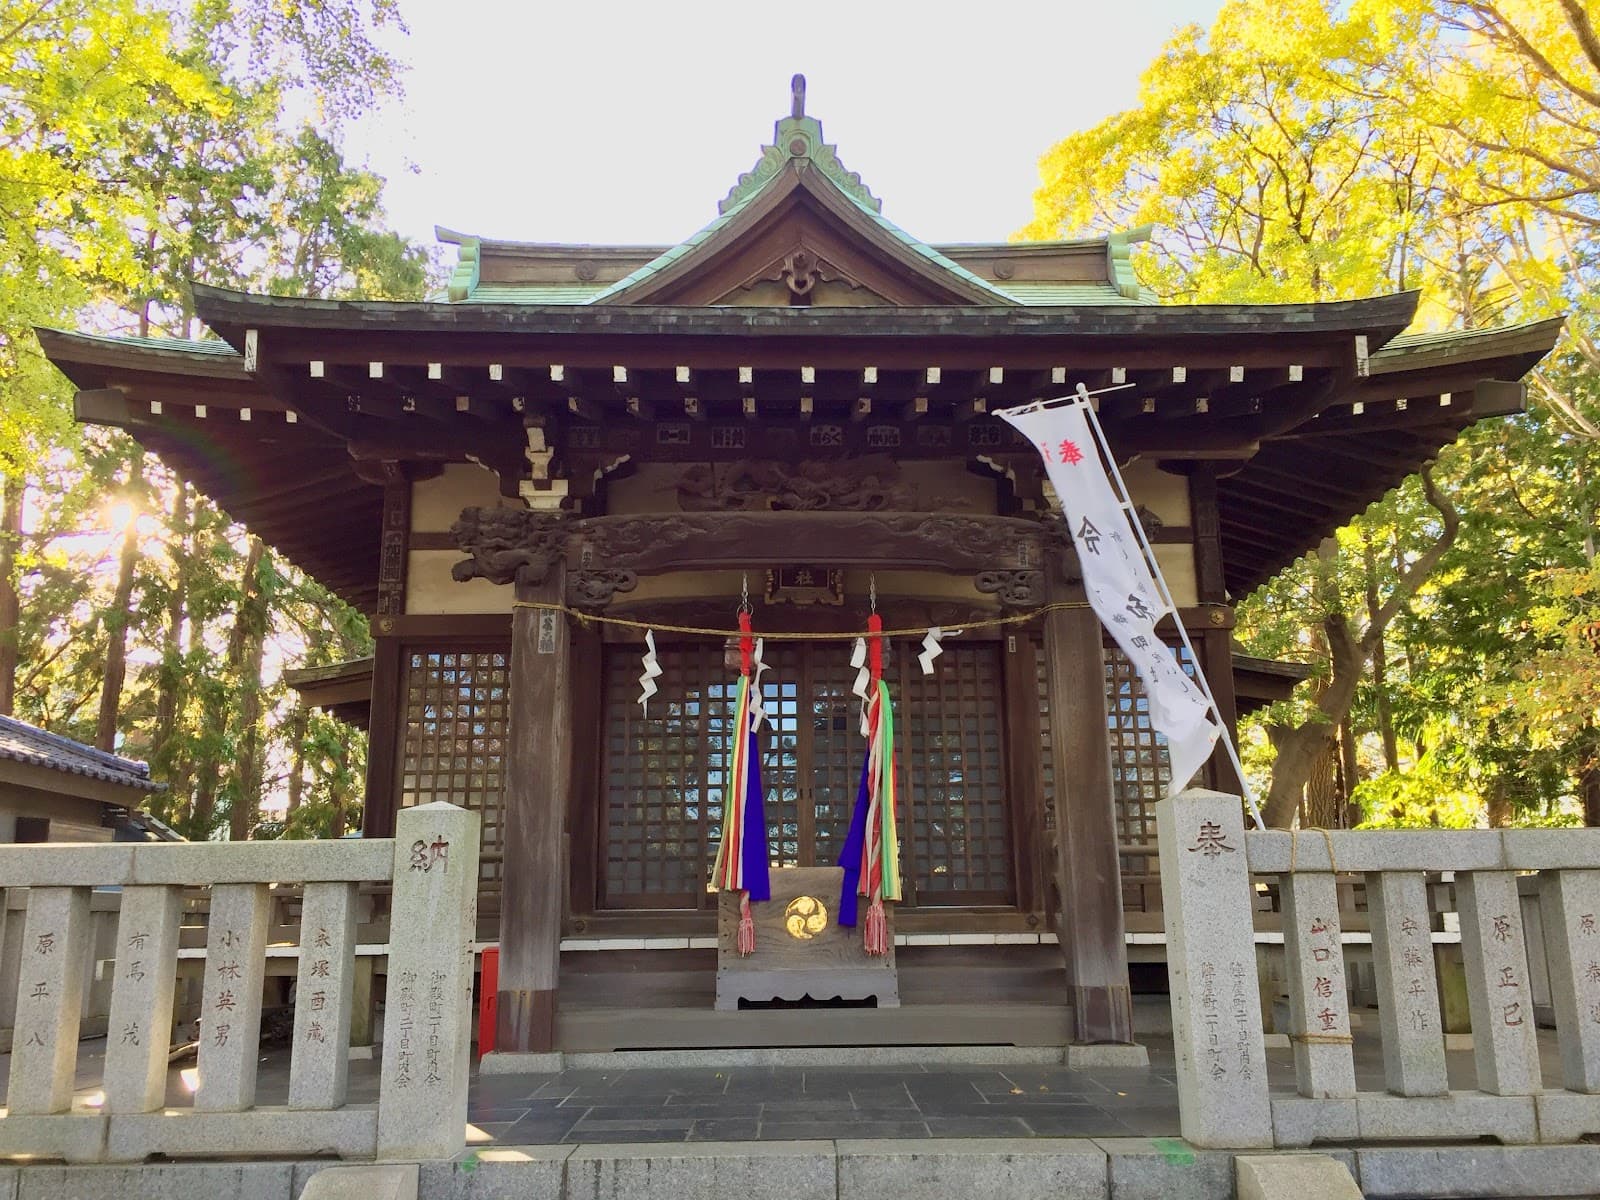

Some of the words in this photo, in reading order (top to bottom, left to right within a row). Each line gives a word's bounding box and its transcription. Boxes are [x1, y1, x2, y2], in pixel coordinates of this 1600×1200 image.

[408, 834, 450, 873] 納
[1188, 821, 1236, 859] 奉
[25, 933, 54, 1047] 原平八
[121, 932, 150, 1047] 有馬茂
[214, 930, 242, 1047] 小林英男
[1310, 917, 1337, 1031] 山口信重
